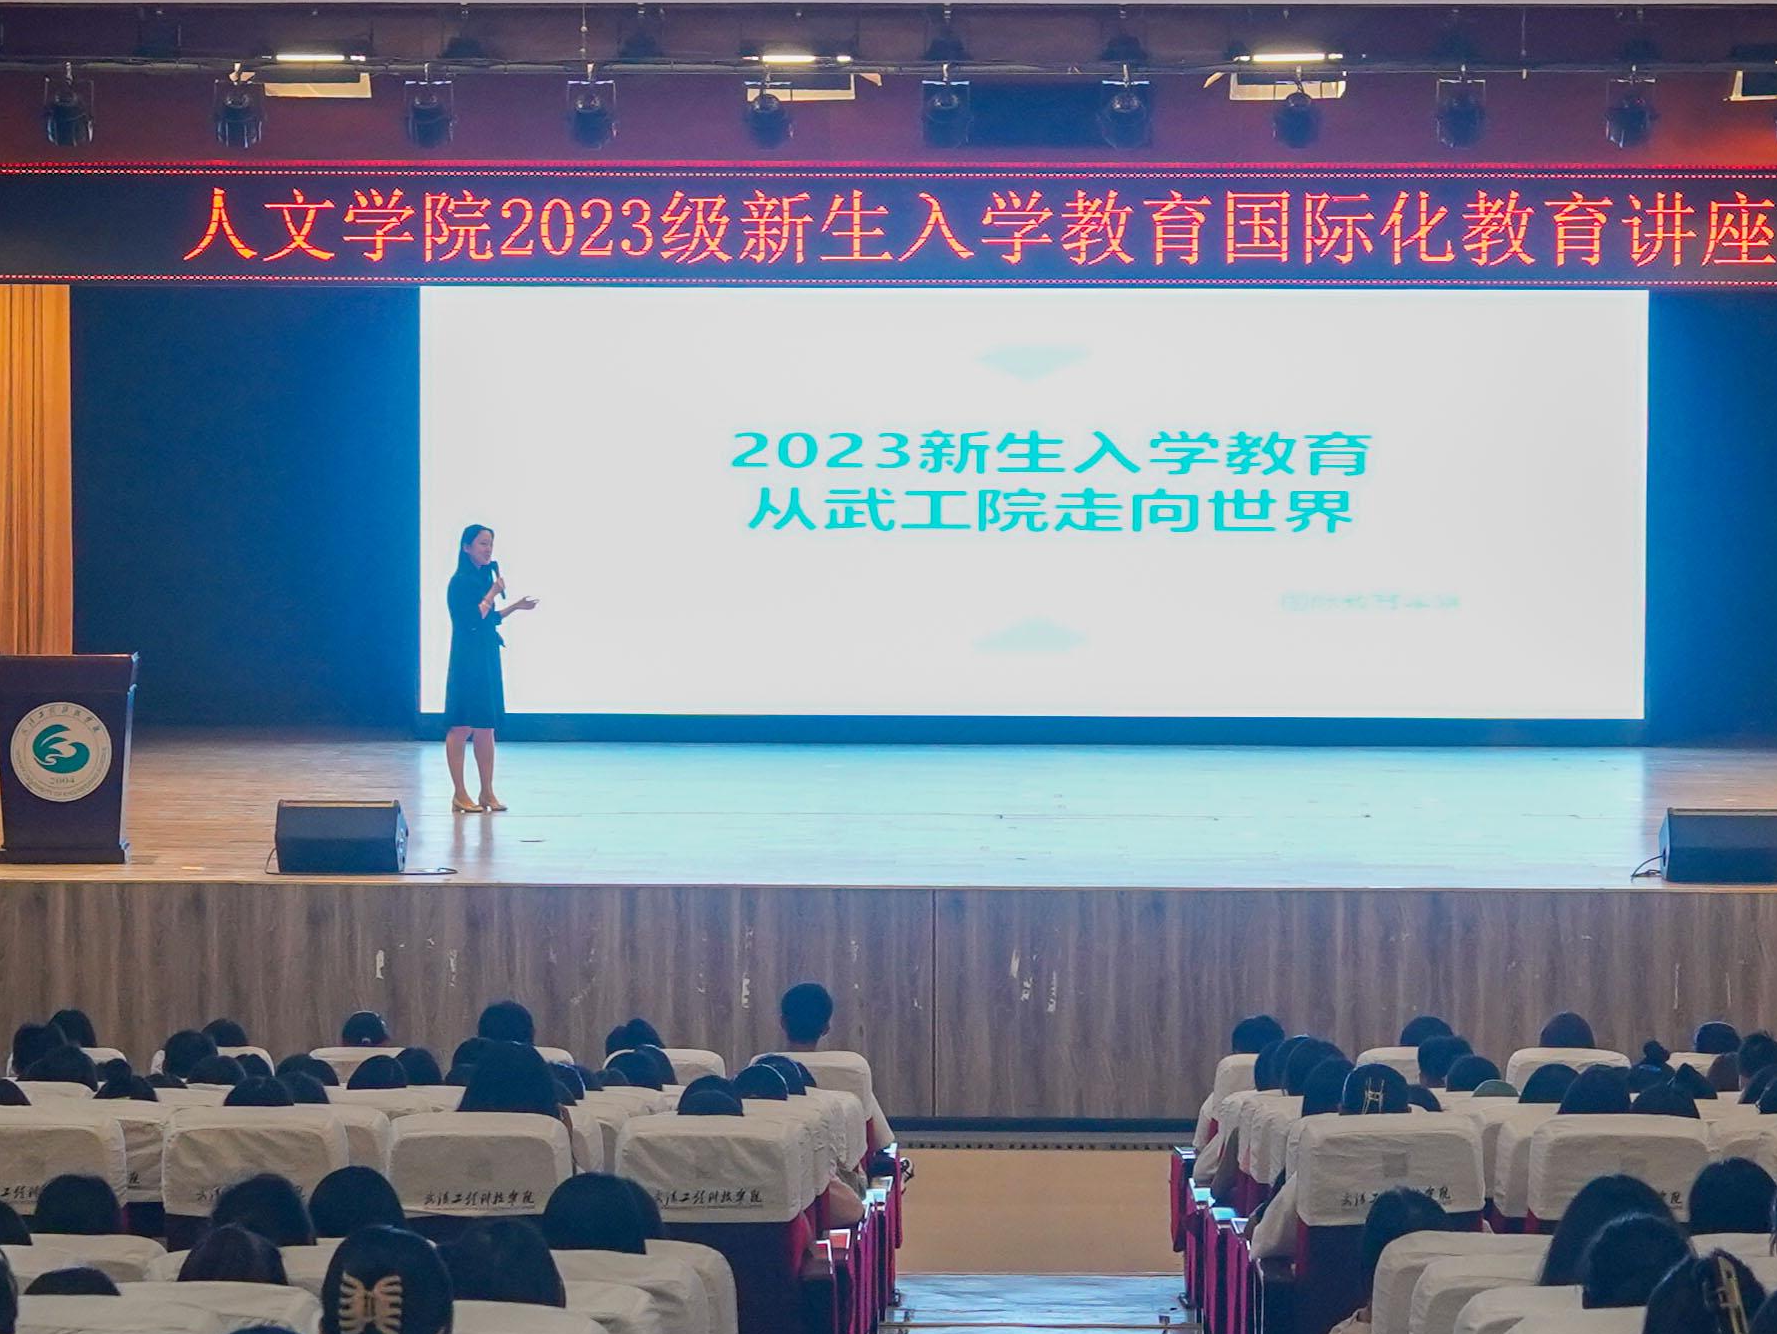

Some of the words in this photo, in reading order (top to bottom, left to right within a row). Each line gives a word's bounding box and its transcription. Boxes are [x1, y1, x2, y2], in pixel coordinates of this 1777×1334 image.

[183, 187, 1777, 267] 人文学院2023级新生入学教育国际化教育讲座
[730, 430, 1374, 476] 2023新生入学教育
[747, 487, 1354, 534] 从武工院走向世界
